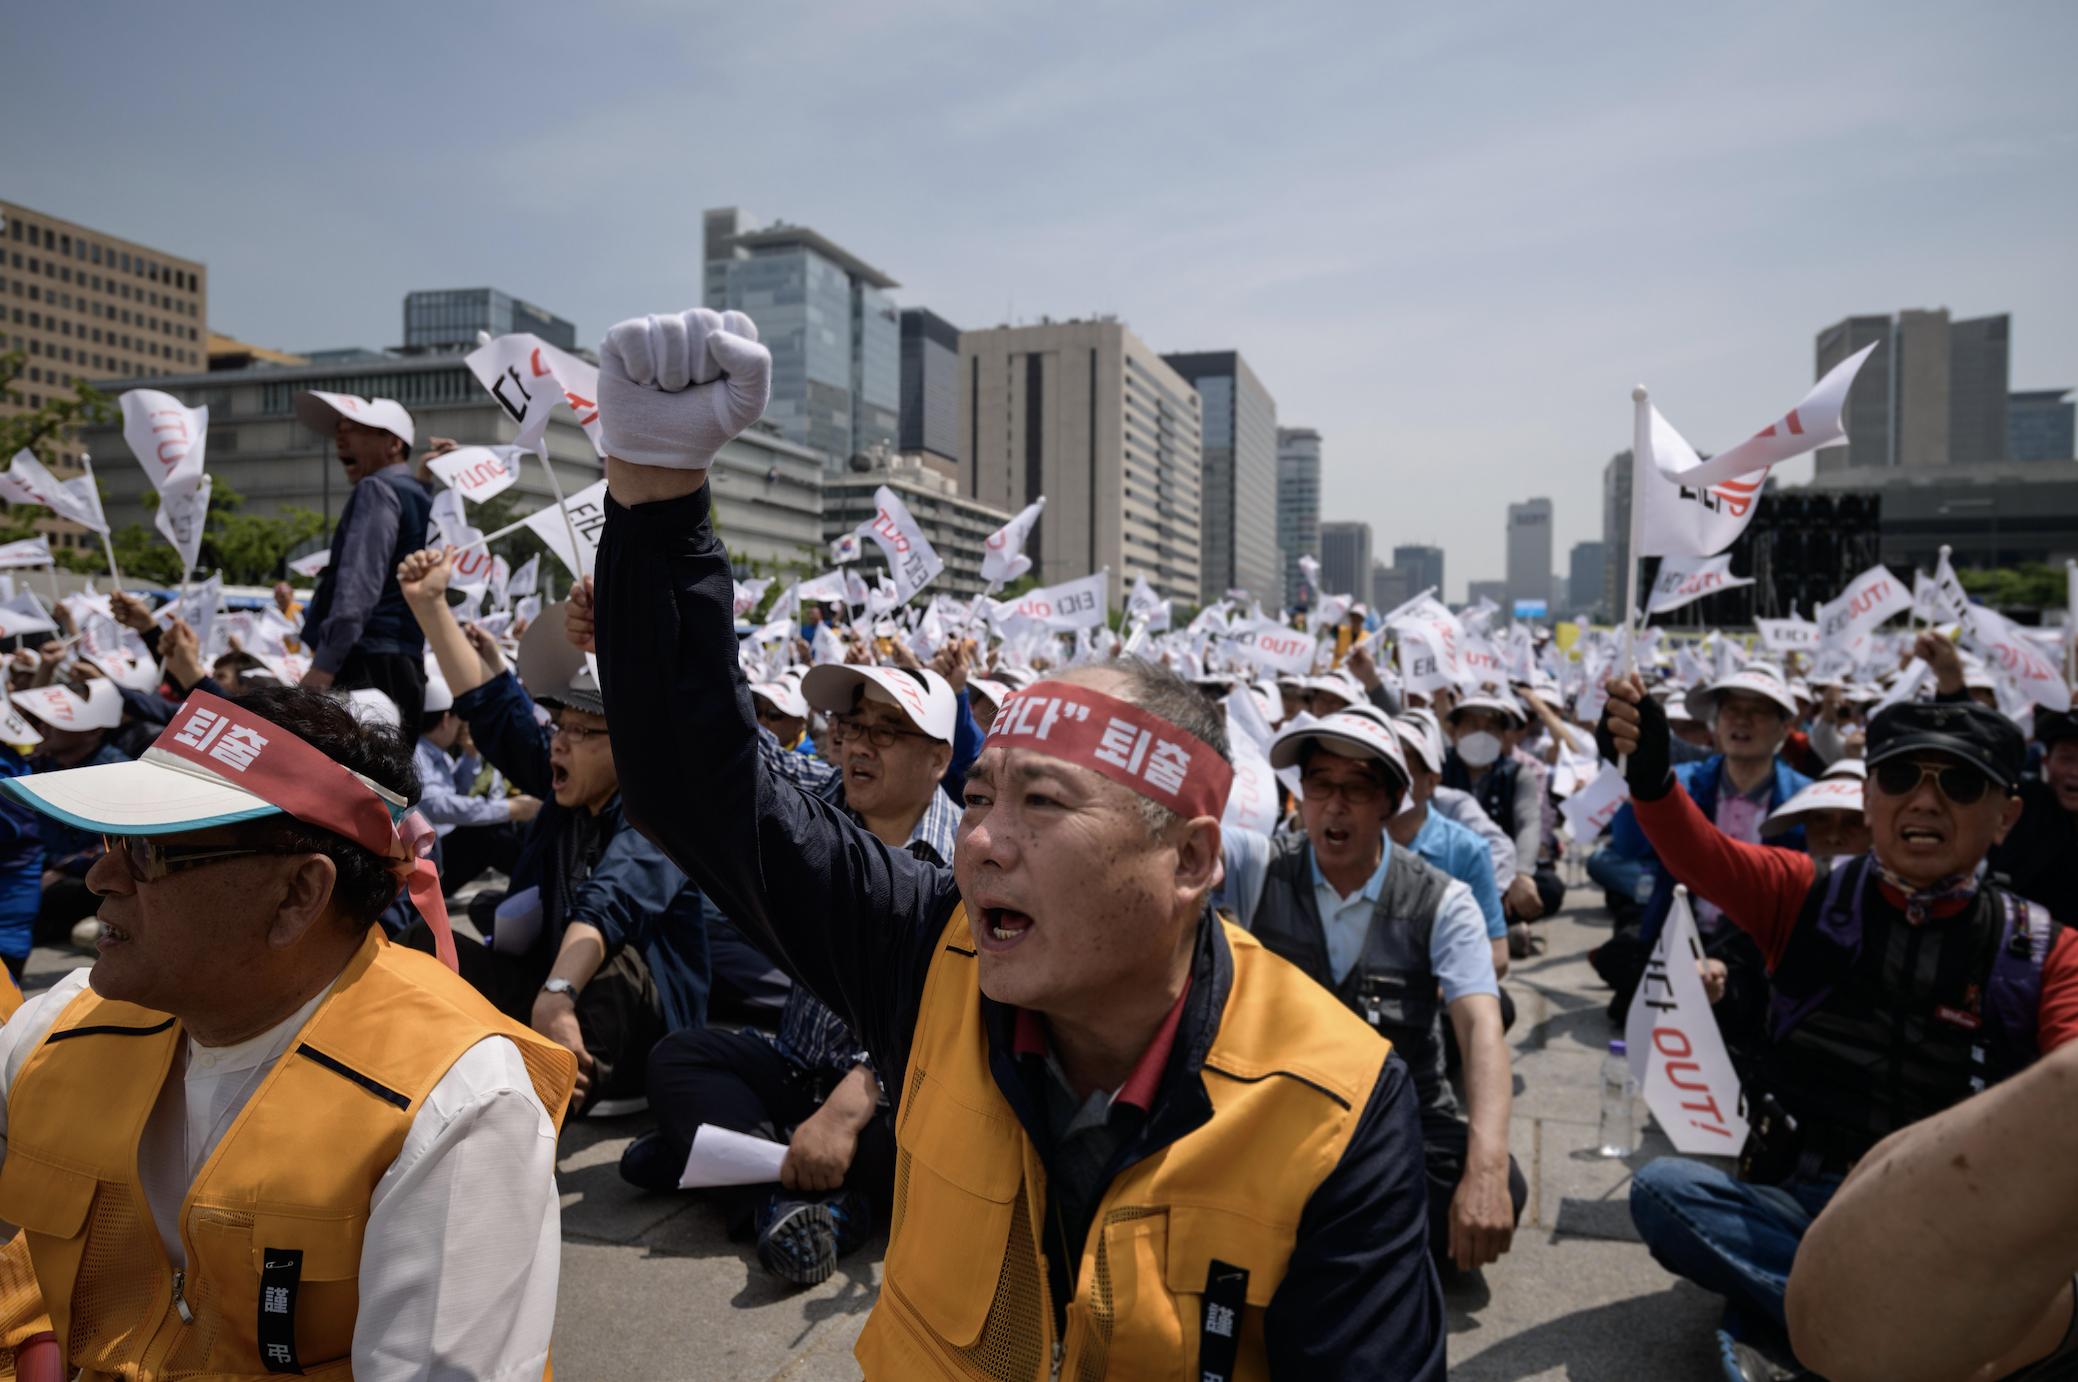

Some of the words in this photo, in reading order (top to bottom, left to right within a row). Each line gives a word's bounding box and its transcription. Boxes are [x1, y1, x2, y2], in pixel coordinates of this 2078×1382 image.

[1260, 635, 1308, 657] OUT!
[173, 706, 270, 773] 퇴출
[1093, 716, 1193, 796] 퇴출
[1652, 1027, 1734, 1139] OUT!
